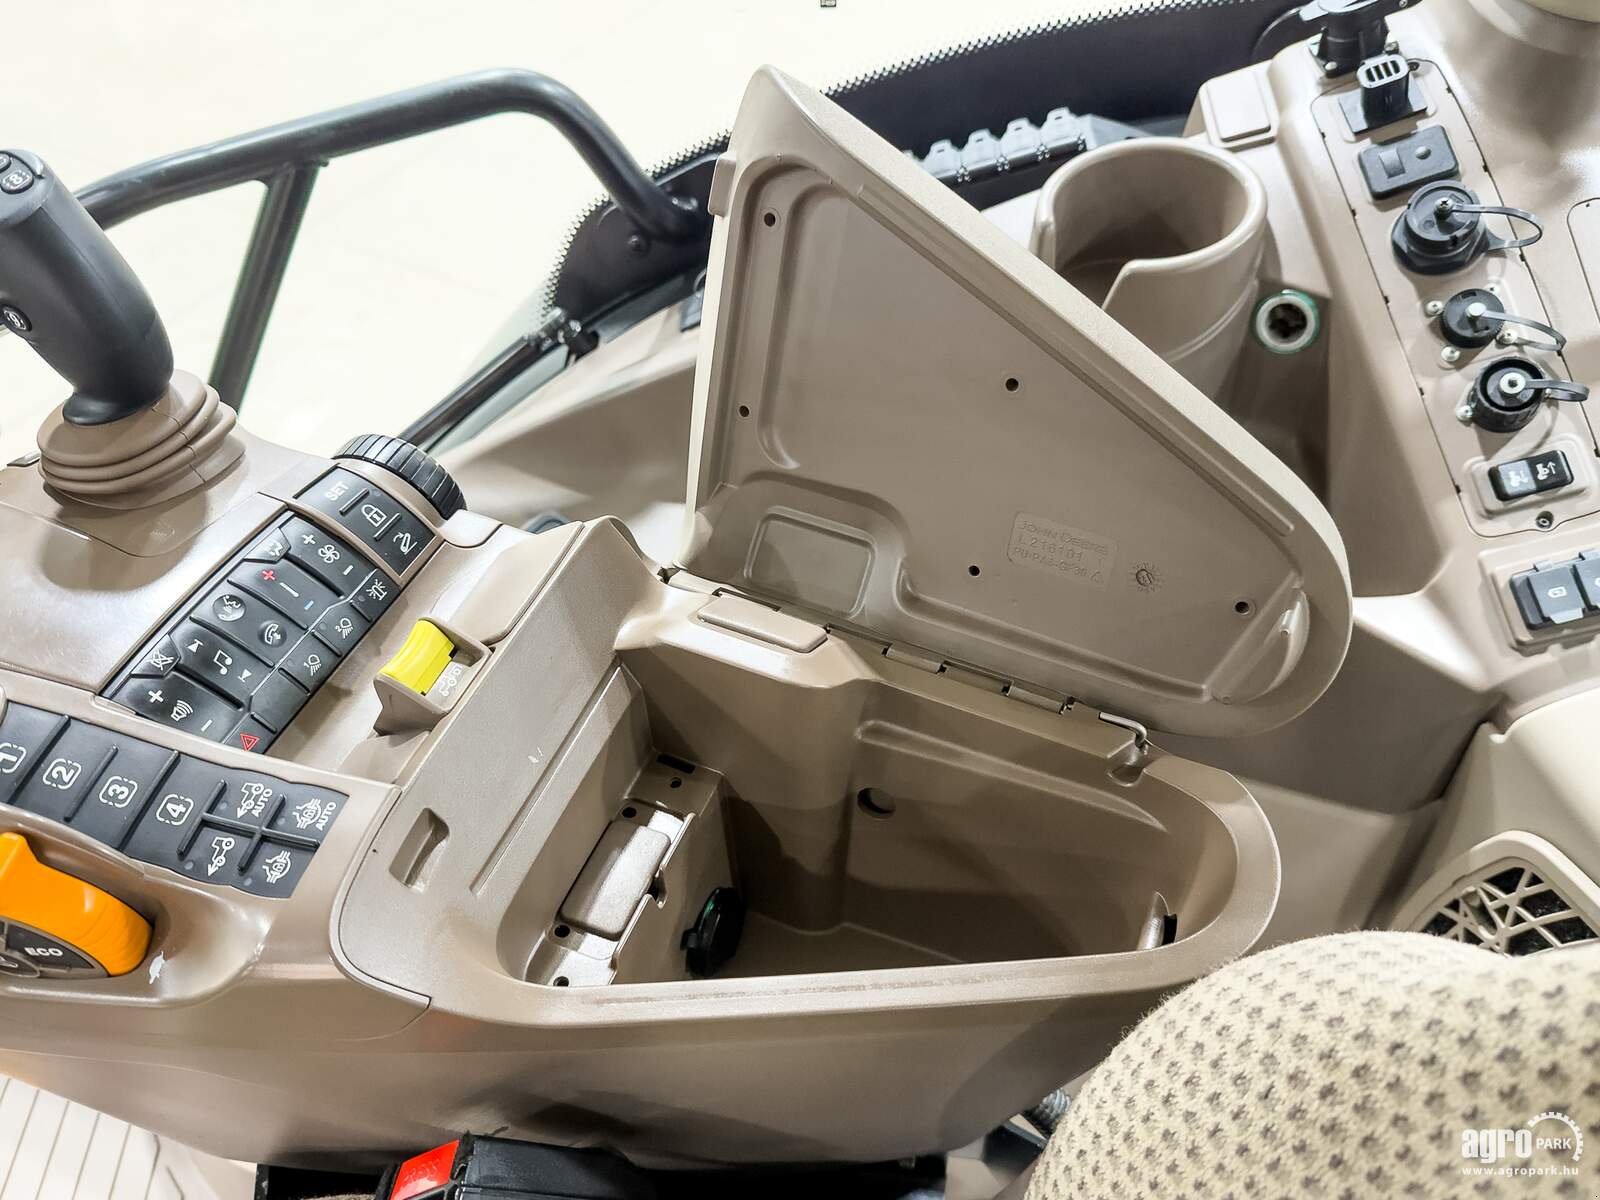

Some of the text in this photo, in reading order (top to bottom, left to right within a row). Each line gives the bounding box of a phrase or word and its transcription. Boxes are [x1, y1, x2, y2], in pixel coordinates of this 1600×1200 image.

[325, 482, 348, 500] SET
[52, 765, 73, 782] 2
[108, 784, 129, 800] 3
[166, 802, 186, 818] 4
[252, 788, 273, 818] AUTO
[316, 802, 337, 831] AUTO
[24, 947, 64, 956] ECO
